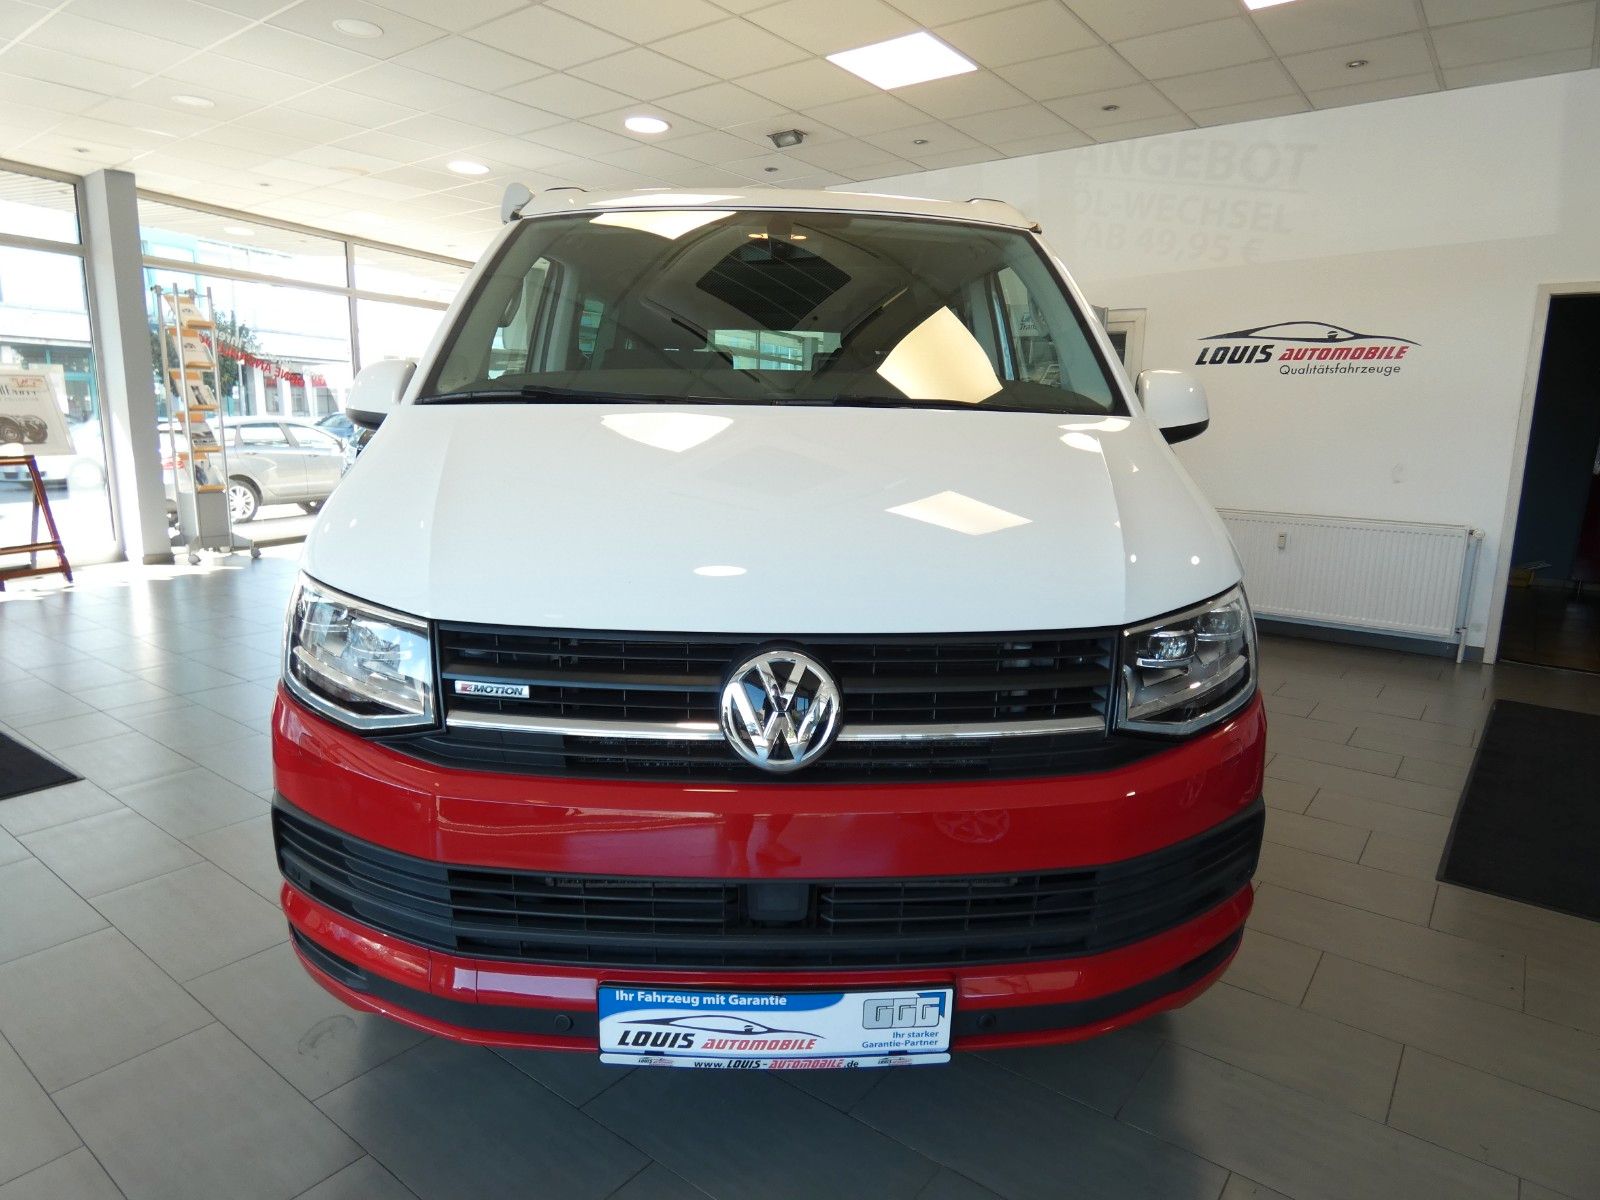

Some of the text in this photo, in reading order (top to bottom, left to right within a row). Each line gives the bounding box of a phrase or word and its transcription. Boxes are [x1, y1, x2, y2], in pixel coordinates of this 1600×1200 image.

[1075, 139, 1318, 186] ANGEBOT
[1084, 222, 1127, 251] AB
[1195, 345, 1409, 365] LOUIS AUTOMOBILE
[1279, 363, 1401, 376] Qualitätsfahrzeuge
[616, 990, 787, 1006] Ihr Fahrzeug mit Garantie
[617, 1030, 817, 1050] LOUIS AUTOMOBILE
[861, 1039, 938, 1049] Garantie-Partner
[907, 1031, 939, 1039] starker
